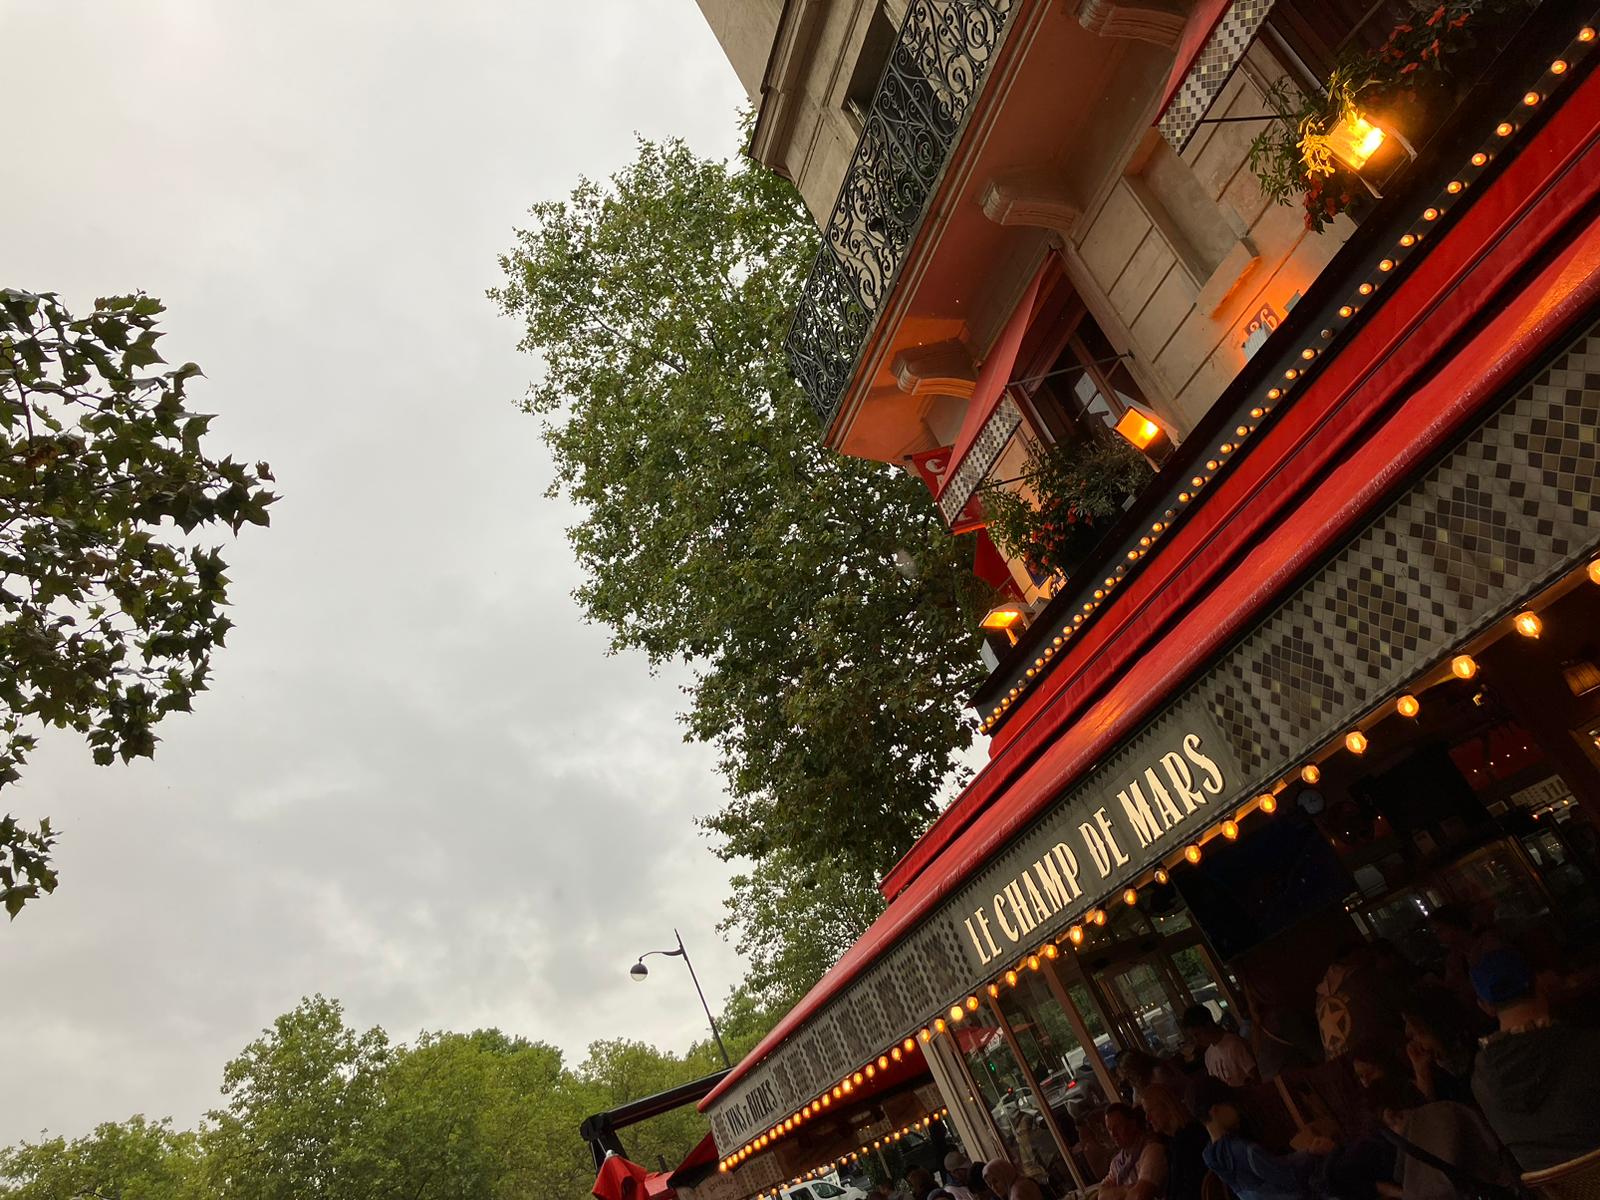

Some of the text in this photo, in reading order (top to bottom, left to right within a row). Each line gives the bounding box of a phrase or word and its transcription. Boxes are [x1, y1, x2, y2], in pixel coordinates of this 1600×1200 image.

[964, 733, 1225, 966] LE CHAMP DE MARS
[725, 1103, 748, 1137] VINS
